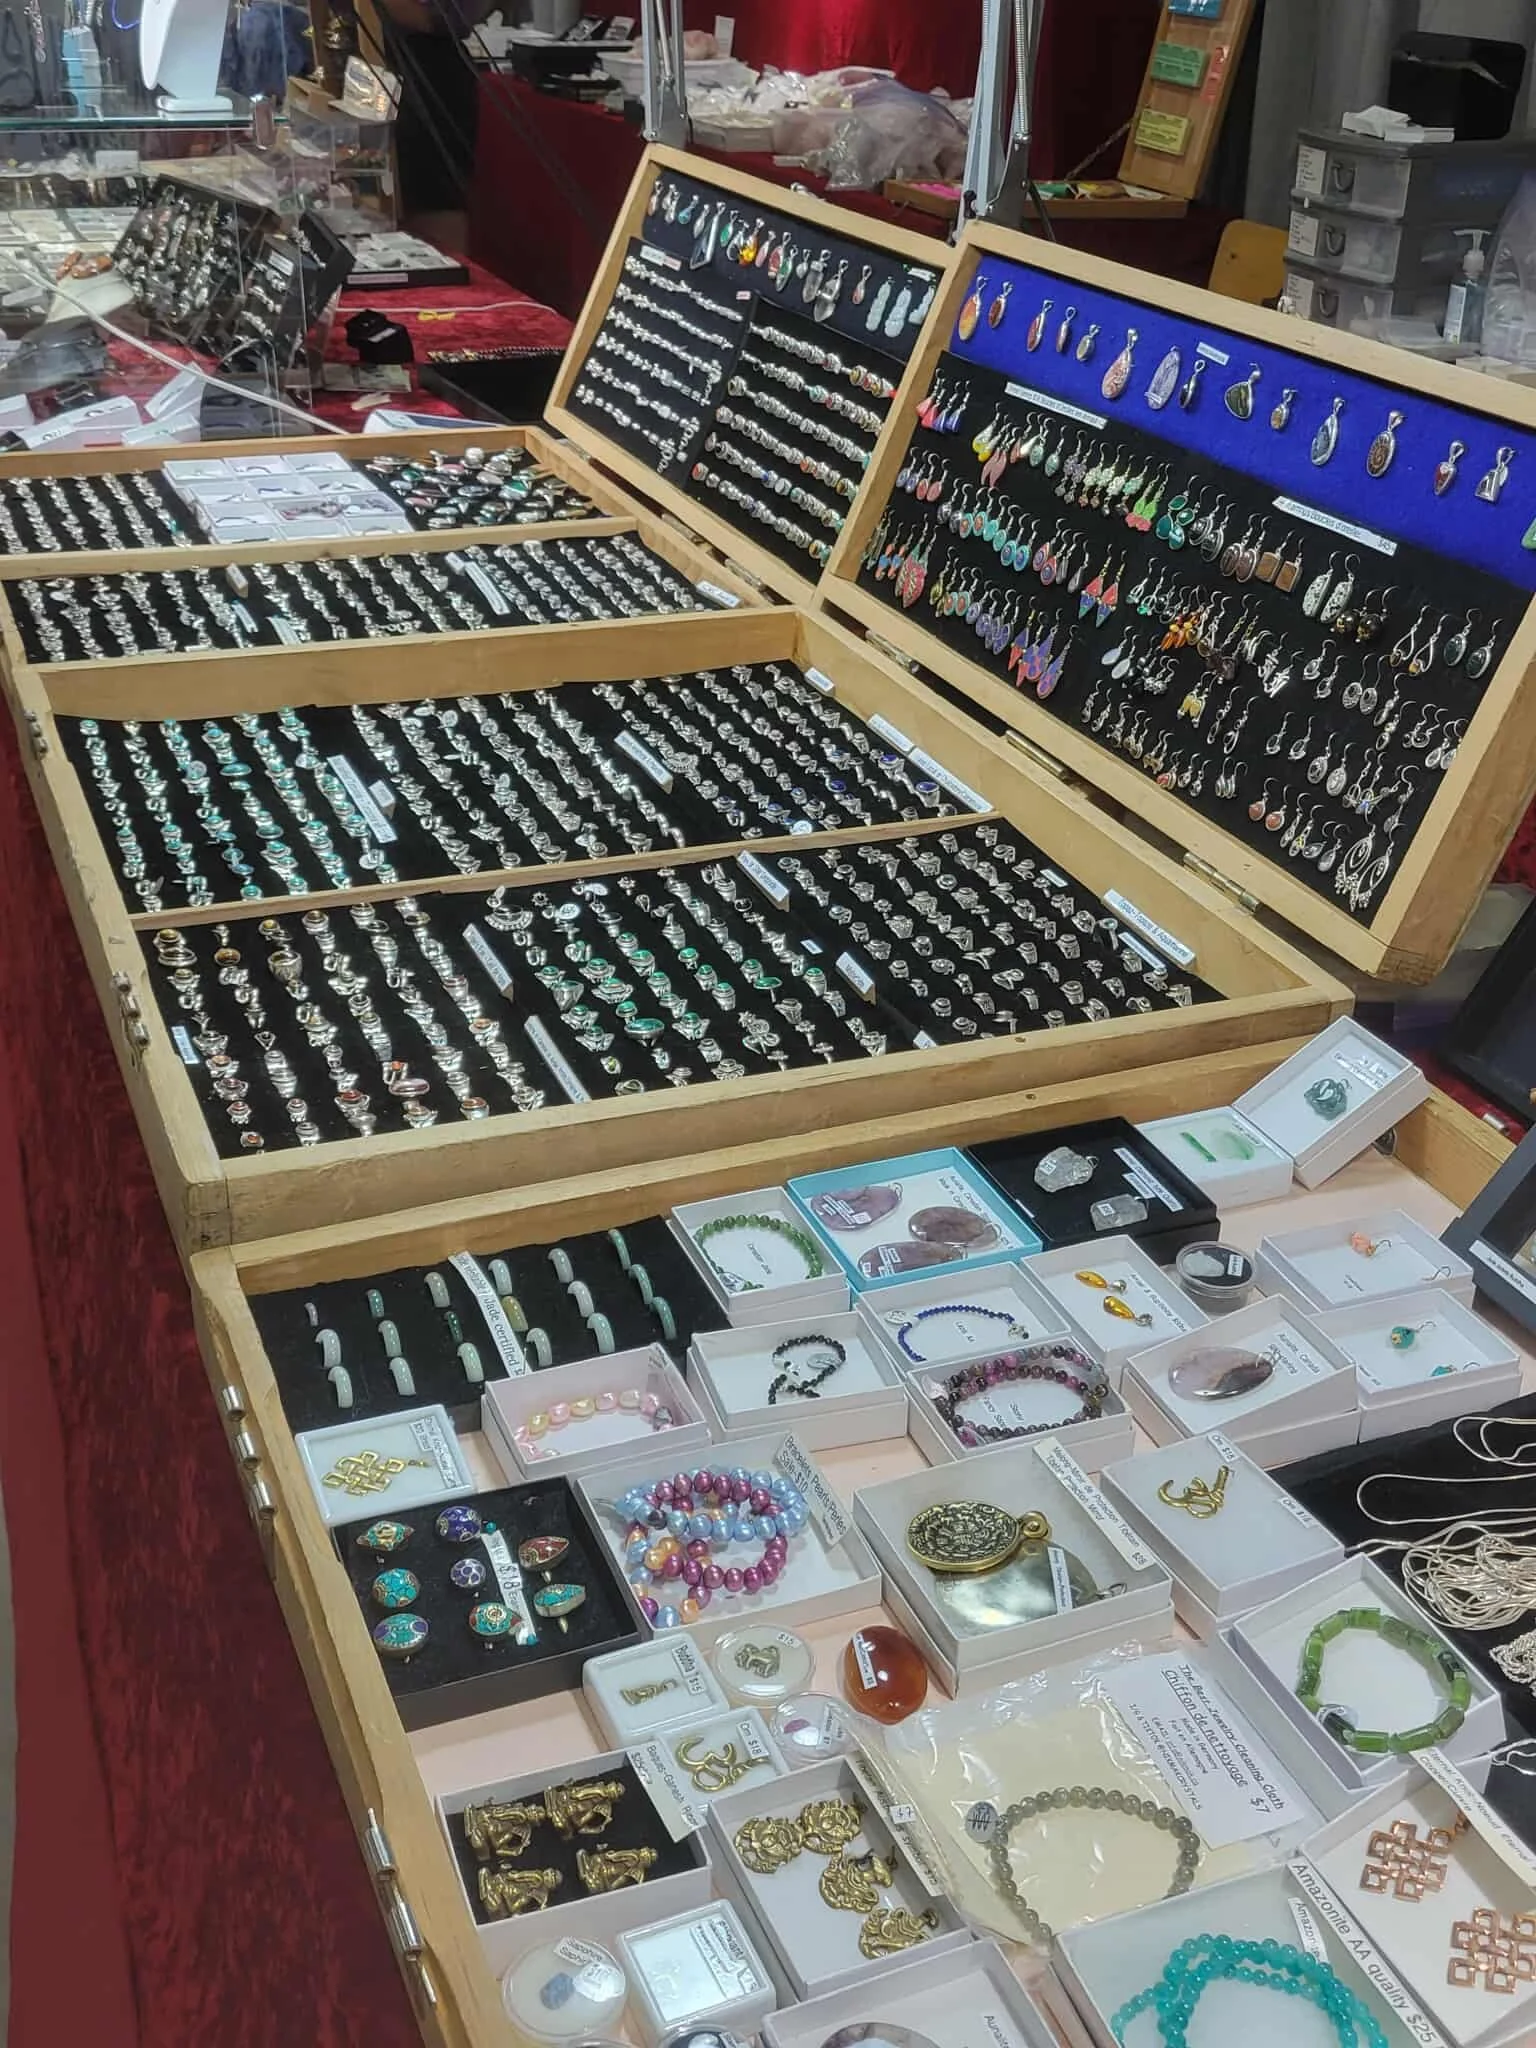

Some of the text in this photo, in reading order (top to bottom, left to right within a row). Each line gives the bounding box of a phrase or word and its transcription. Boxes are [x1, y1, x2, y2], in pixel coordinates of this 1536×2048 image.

[484, 1297, 521, 1368] Jade certified
[499, 1564, 522, 1591] $18
[1163, 1668, 1198, 1714] Chiffon
[1192, 1711, 1209, 1728] de
[1204, 1727, 1250, 1789] nettoyage
[1234, 1741, 1265, 1787] Cleaning
[1262, 1782, 1285, 1811] Cloth
[1250, 1797, 1272, 1814] $7
[1292, 1863, 1437, 2044] Amazonite AA quality $25
